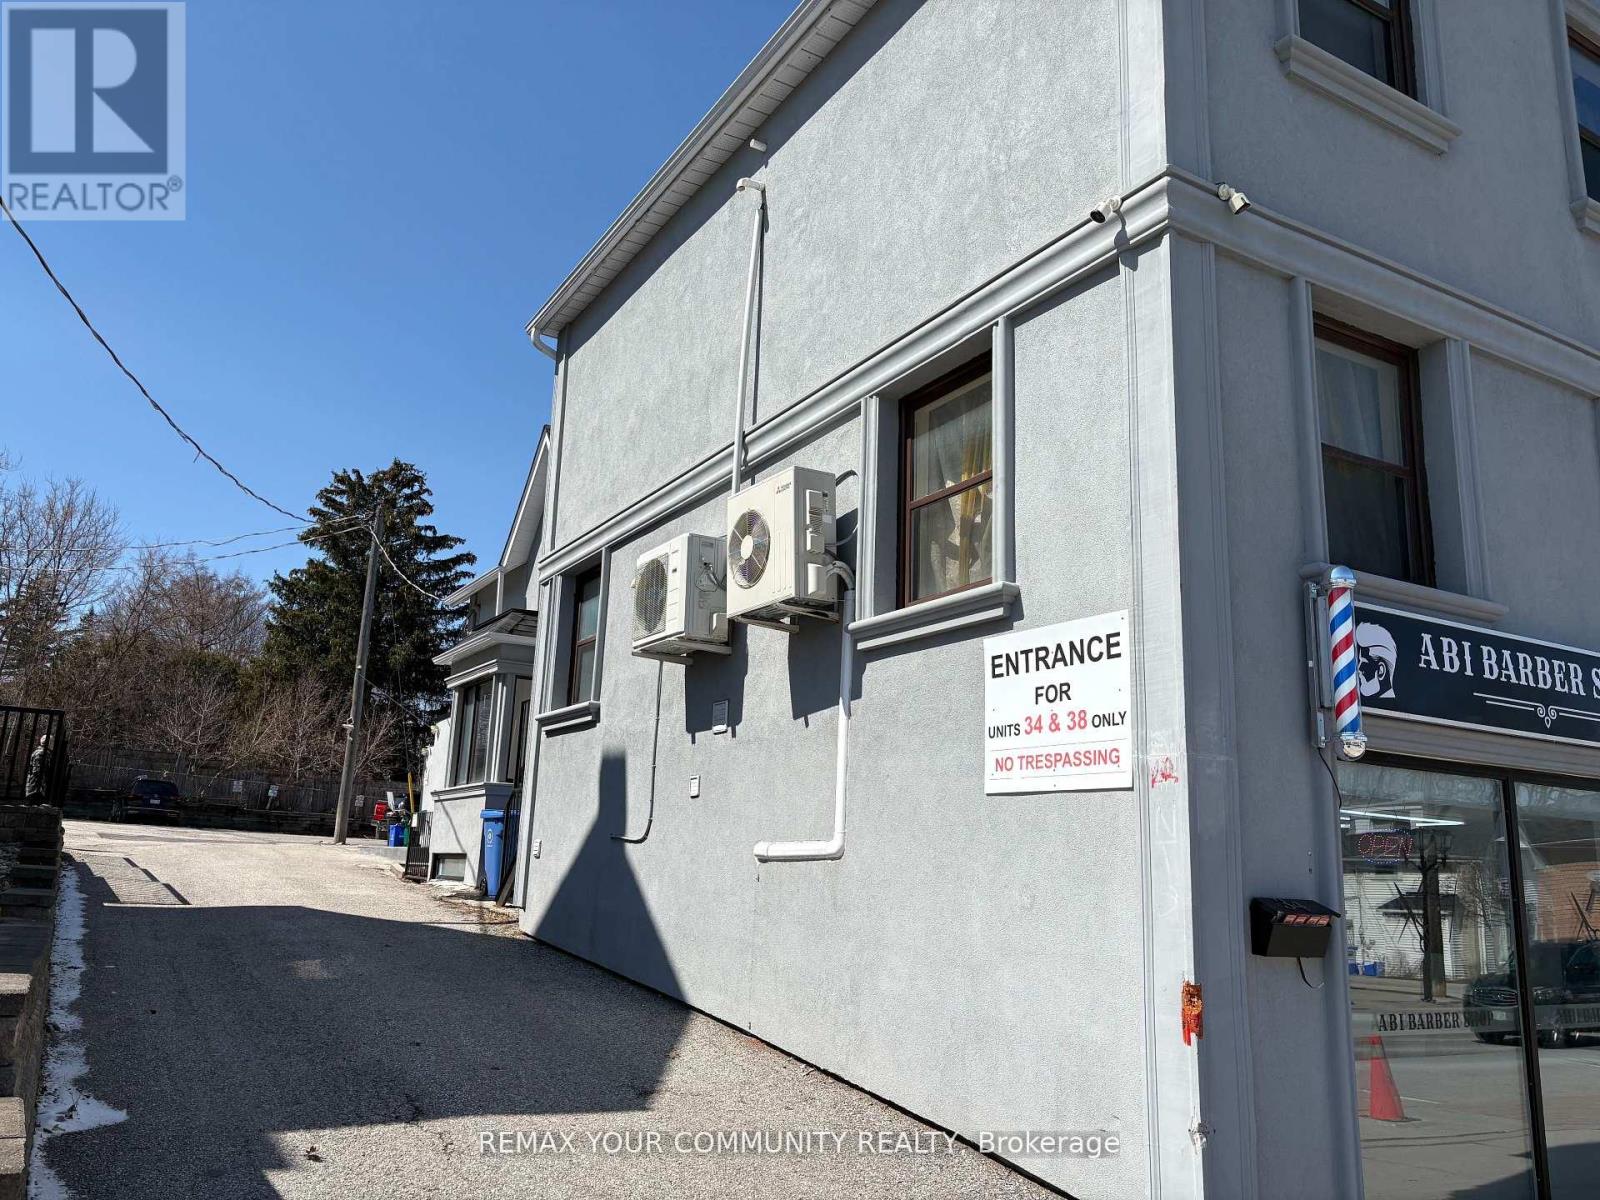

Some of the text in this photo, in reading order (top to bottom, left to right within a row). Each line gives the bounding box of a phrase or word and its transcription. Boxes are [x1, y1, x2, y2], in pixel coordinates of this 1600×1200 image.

[990, 631, 1122, 679] ENTRANCE
[1418, 632, 1475, 677] ABI
[1480, 645, 1587, 697] BARBER
[1034, 682, 1072, 705] FOR
[988, 709, 1127, 739] UNITS 34 & 38 ONLY
[995, 747, 1121, 772] NO TRESPASSING
[1378, 1013, 1405, 1031] ABI
[1407, 1012, 1461, 1030] BARBER
